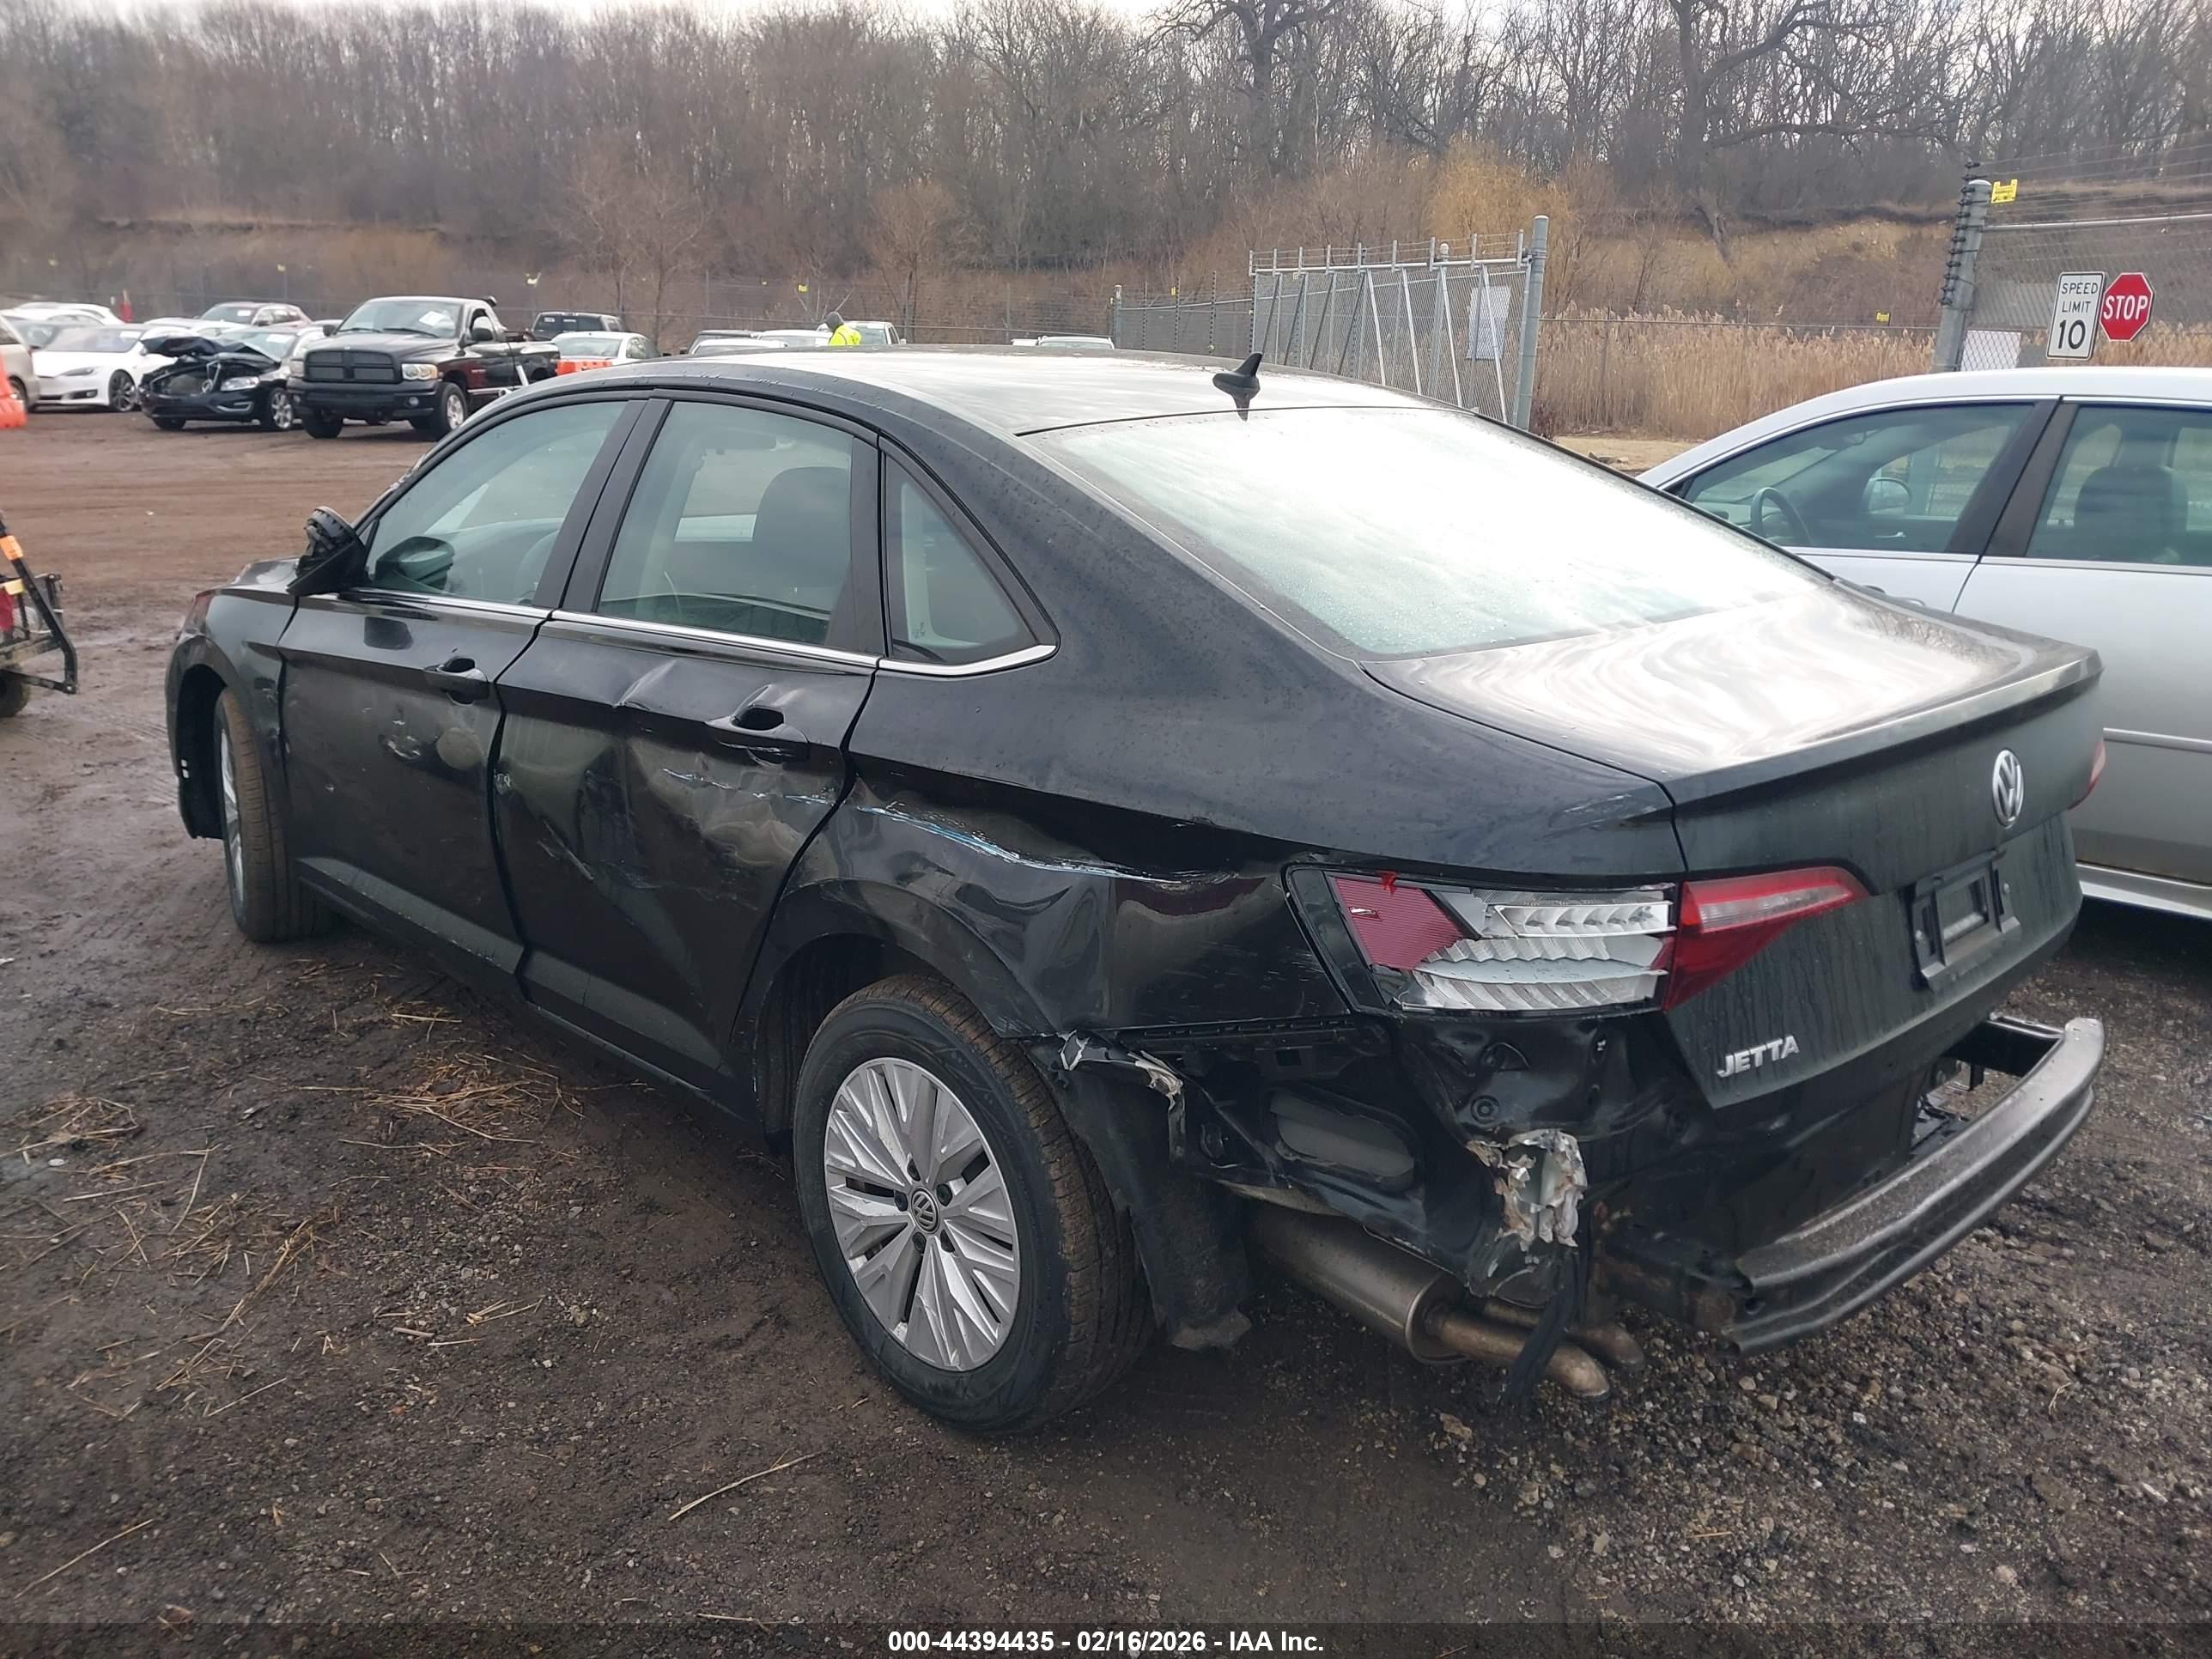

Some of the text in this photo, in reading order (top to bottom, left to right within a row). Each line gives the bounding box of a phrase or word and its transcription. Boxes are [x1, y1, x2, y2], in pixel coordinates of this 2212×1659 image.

[2061, 283, 2098, 294] SPEED
[2062, 301, 2092, 313] LIMIT
[2103, 295, 2148, 320] STOP
[2057, 319, 2086, 349] 10
[1717, 1036, 1800, 1078] JETTA
